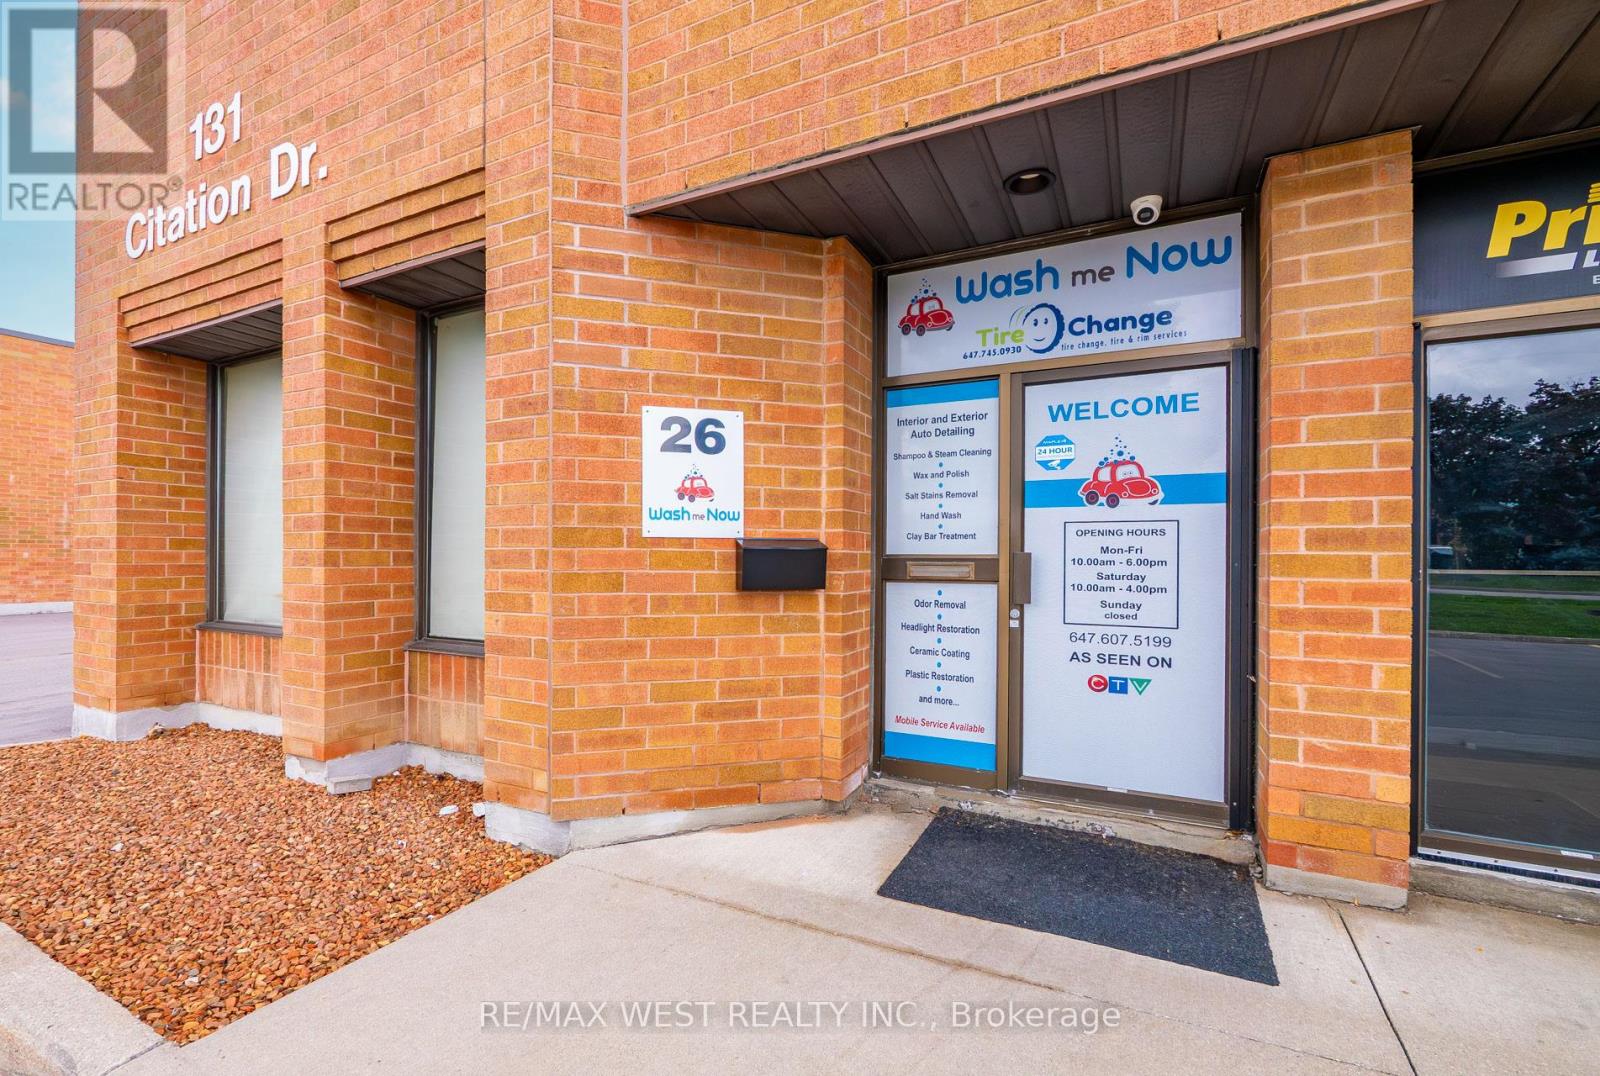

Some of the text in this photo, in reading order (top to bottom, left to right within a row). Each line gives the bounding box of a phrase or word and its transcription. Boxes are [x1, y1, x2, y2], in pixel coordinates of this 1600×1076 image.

[189, 90, 241, 161] 131
[124, 141, 328, 259] Citation Dr.
[955, 235, 1233, 304] Wash me Now
[976, 308, 1172, 348] Tire Change
[1061, 342, 1074, 351] tire
[1110, 337, 1125, 346] tire
[1128, 335, 1133, 343] &
[1137, 334, 1150, 343] rim
[1153, 330, 1188, 341] services
[963, 346, 1022, 360] 647.745.0930
[1048, 392, 1200, 423] WELCOME
[897, 412, 988, 426] Interior and Exterior
[660, 416, 726, 455] 26
[911, 427, 975, 439] Auto Detailing
[894, 453, 926, 461] Shampoo
[959, 448, 992, 456] Cleaning
[946, 470, 969, 478] Polish
[649, 507, 690, 521] Wash
[707, 508, 740, 522] Now
[906, 533, 922, 541] Clay
[1076, 529, 1123, 537] OPENING
[1100, 546, 1143, 554] Mon-Fri
[1071, 558, 1115, 566] 10.00am
[1126, 558, 1167, 568] 6.00pm
[1097, 572, 1146, 583] Saturday
[1071, 584, 1115, 592] 10.00am
[1126, 585, 1167, 595] 4.00pm
[914, 599, 966, 609] Odor Removal
[1100, 600, 1142, 611] Sunday
[1104, 612, 1137, 620] closed
[901, 623, 980, 634] Headlight Restoration
[1069, 632, 1172, 648] 647.607.5199
[910, 647, 970, 660] Ceramic Coating
[1070, 652, 1172, 668] AS SEEN ON
[905, 670, 974, 683] Plastic Restoration
[1088, 674, 1152, 695] CTV
[919, 695, 959, 706] and more...
[895, 715, 985, 734] Mobile Service Available
